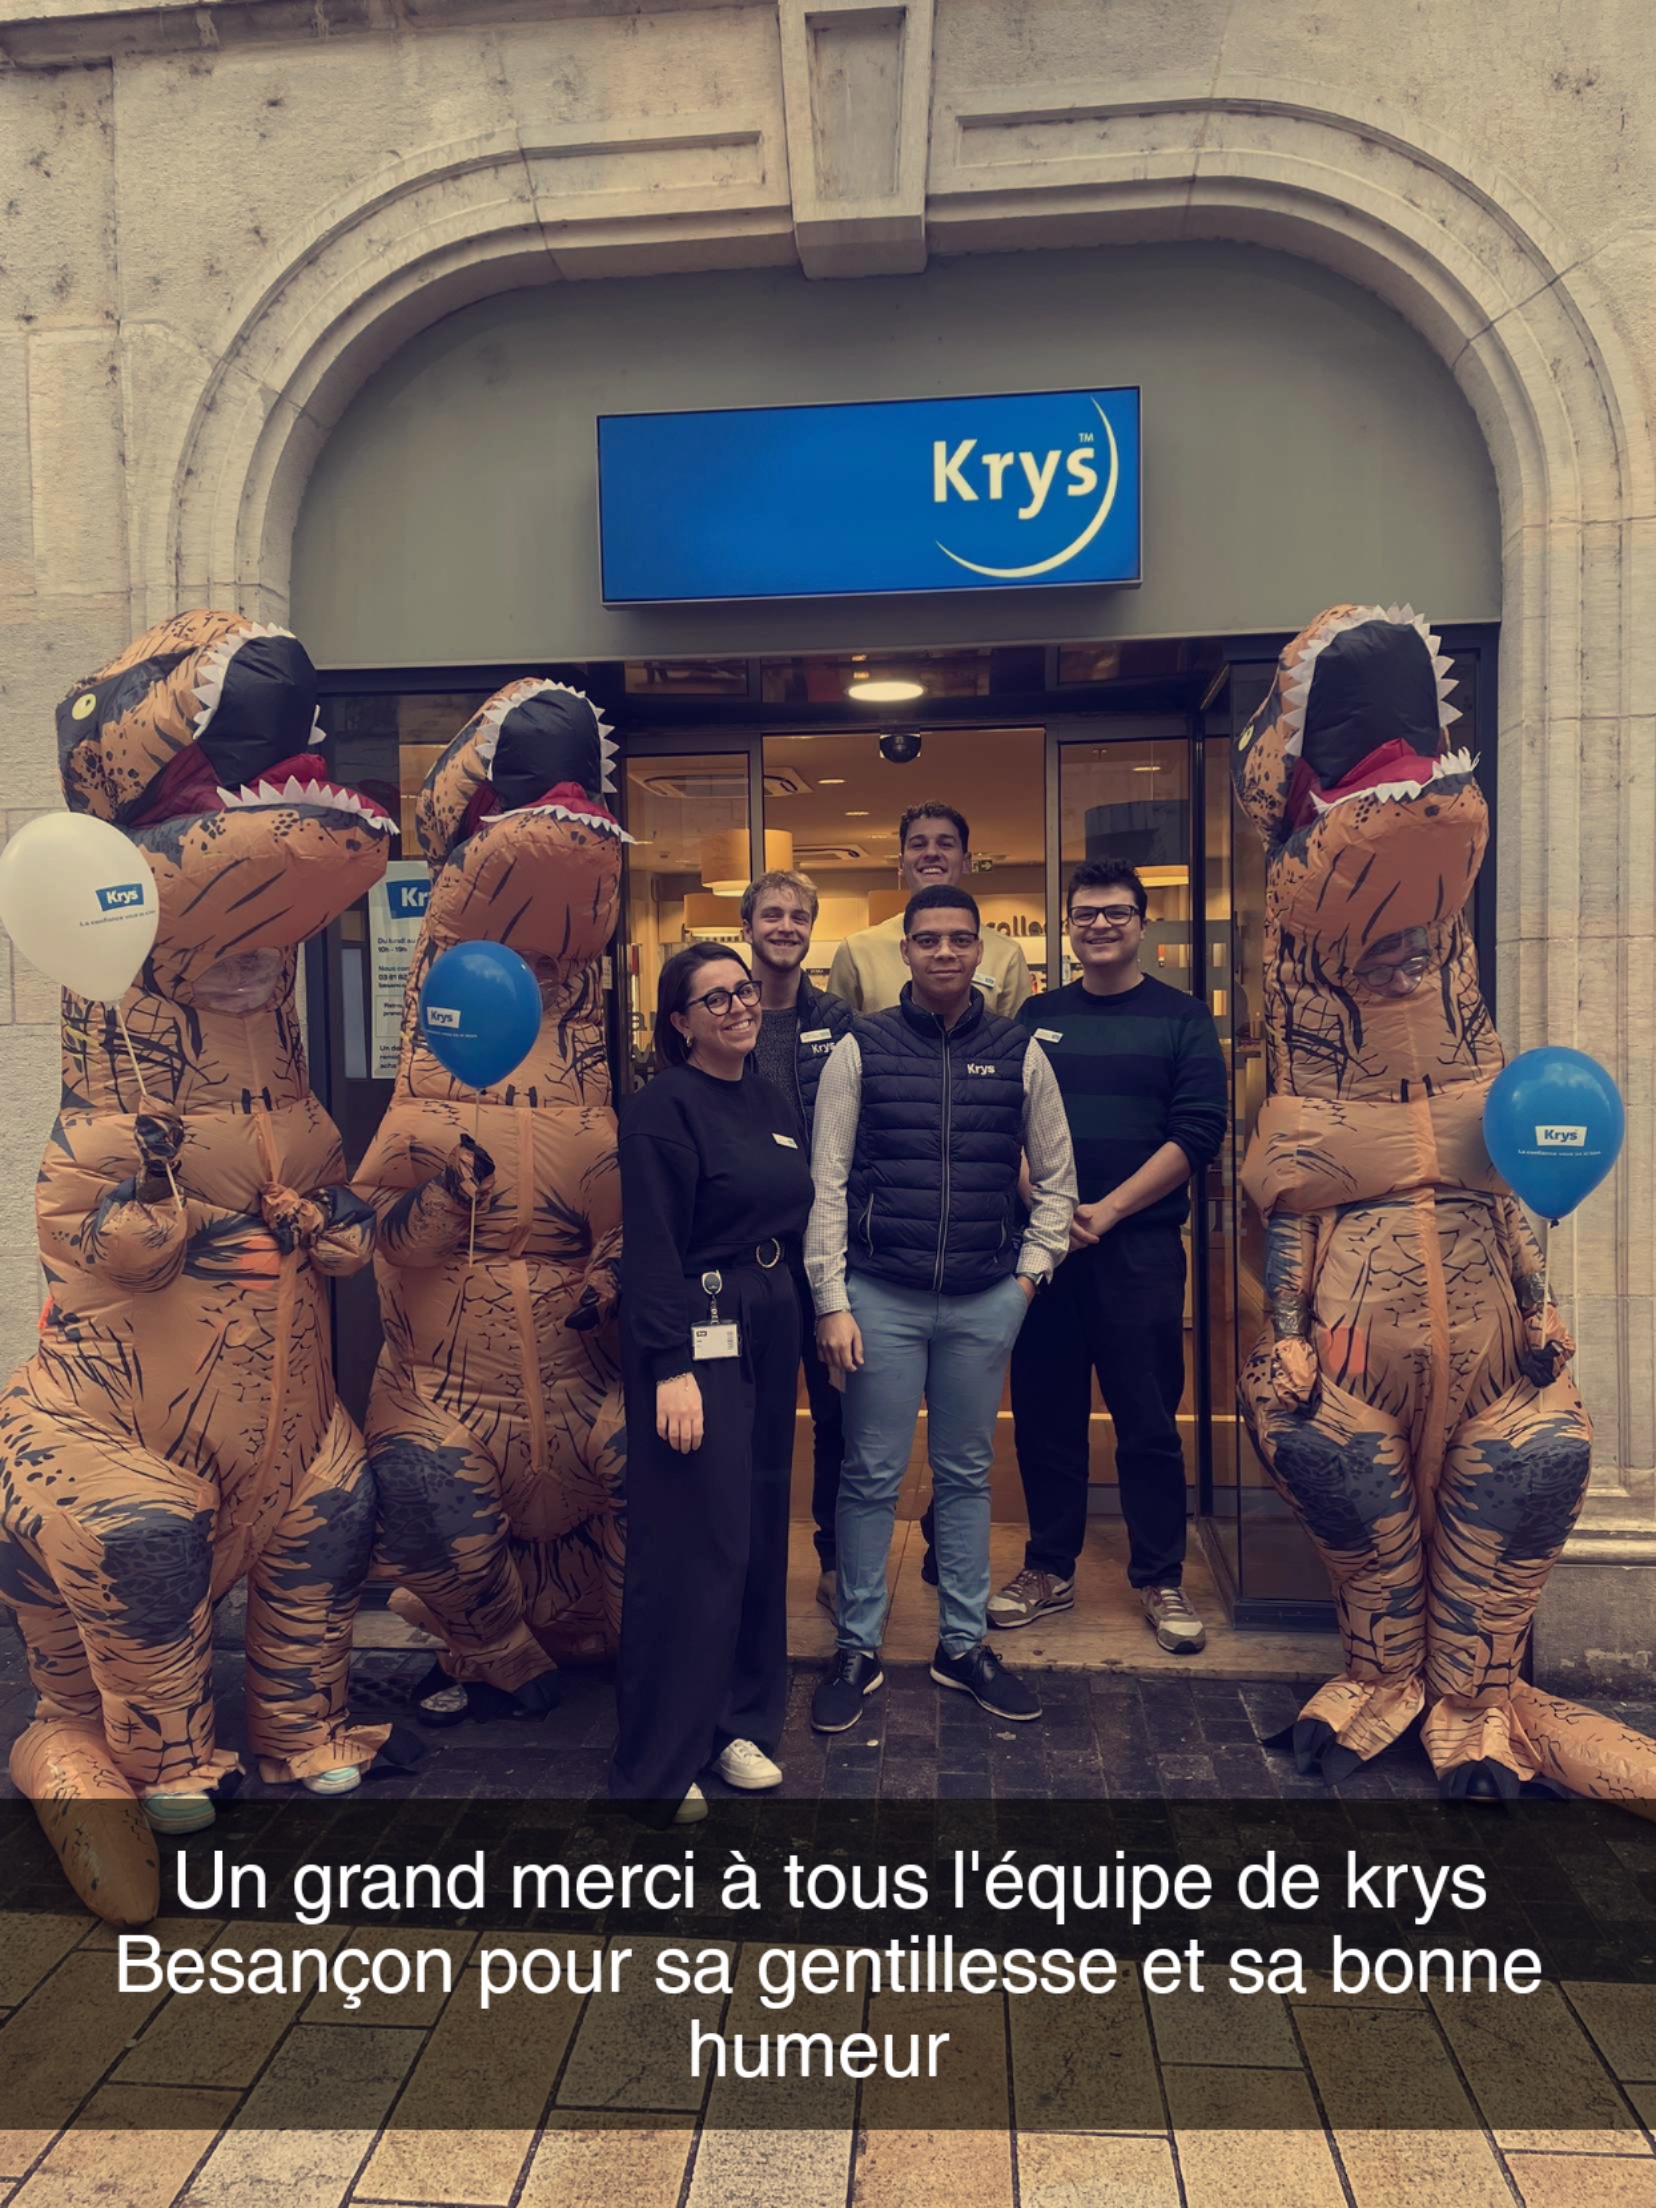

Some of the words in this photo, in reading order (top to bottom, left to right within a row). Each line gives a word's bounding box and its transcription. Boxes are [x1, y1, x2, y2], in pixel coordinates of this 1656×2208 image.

[933, 438, 1098, 520] Krys
[106, 889, 139, 904] Krys
[401, 886, 430, 907] Kr
[431, 1010, 453, 1024] Krys
[967, 1063, 995, 1075] Krys
[1544, 1129, 1578, 1143] Krys
